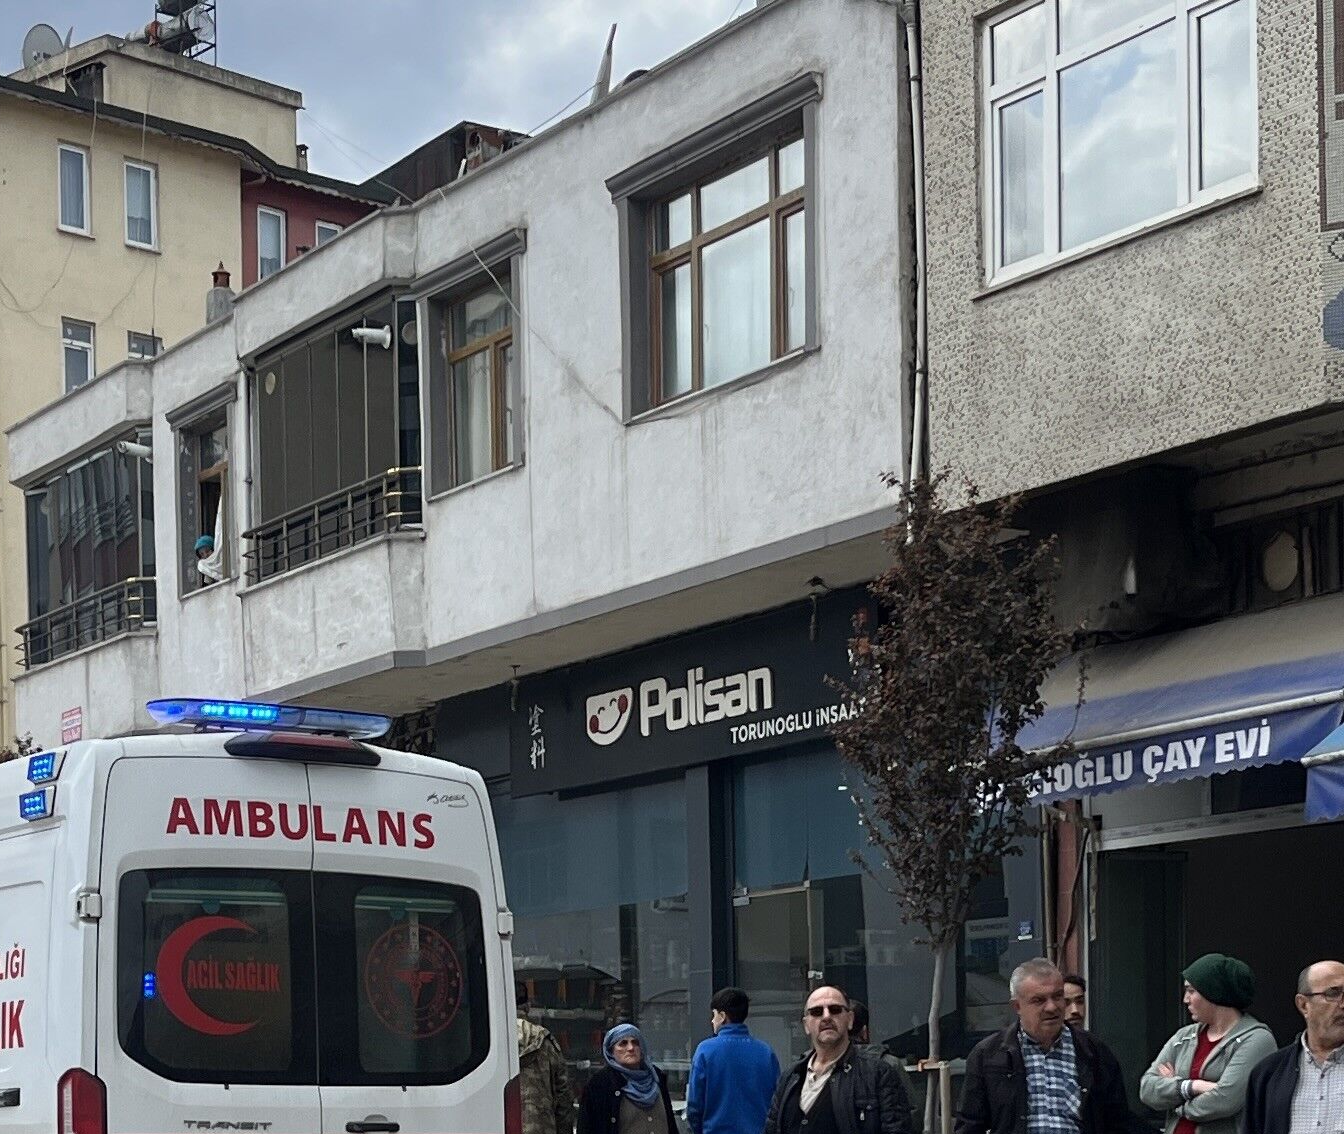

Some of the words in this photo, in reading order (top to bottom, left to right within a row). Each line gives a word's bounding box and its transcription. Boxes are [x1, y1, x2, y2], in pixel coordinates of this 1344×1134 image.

[639, 666, 774, 738] Polisan
[730, 710, 812, 744] TORUNOGLU
[1142, 736, 1206, 783] ÇAY
[1215, 719, 1271, 764] EVİ
[166, 797, 435, 849] AMBULANS
[225, 955, 281, 993] SAĞLIK
[183, 1119, 273, 1131] TRANSIT
